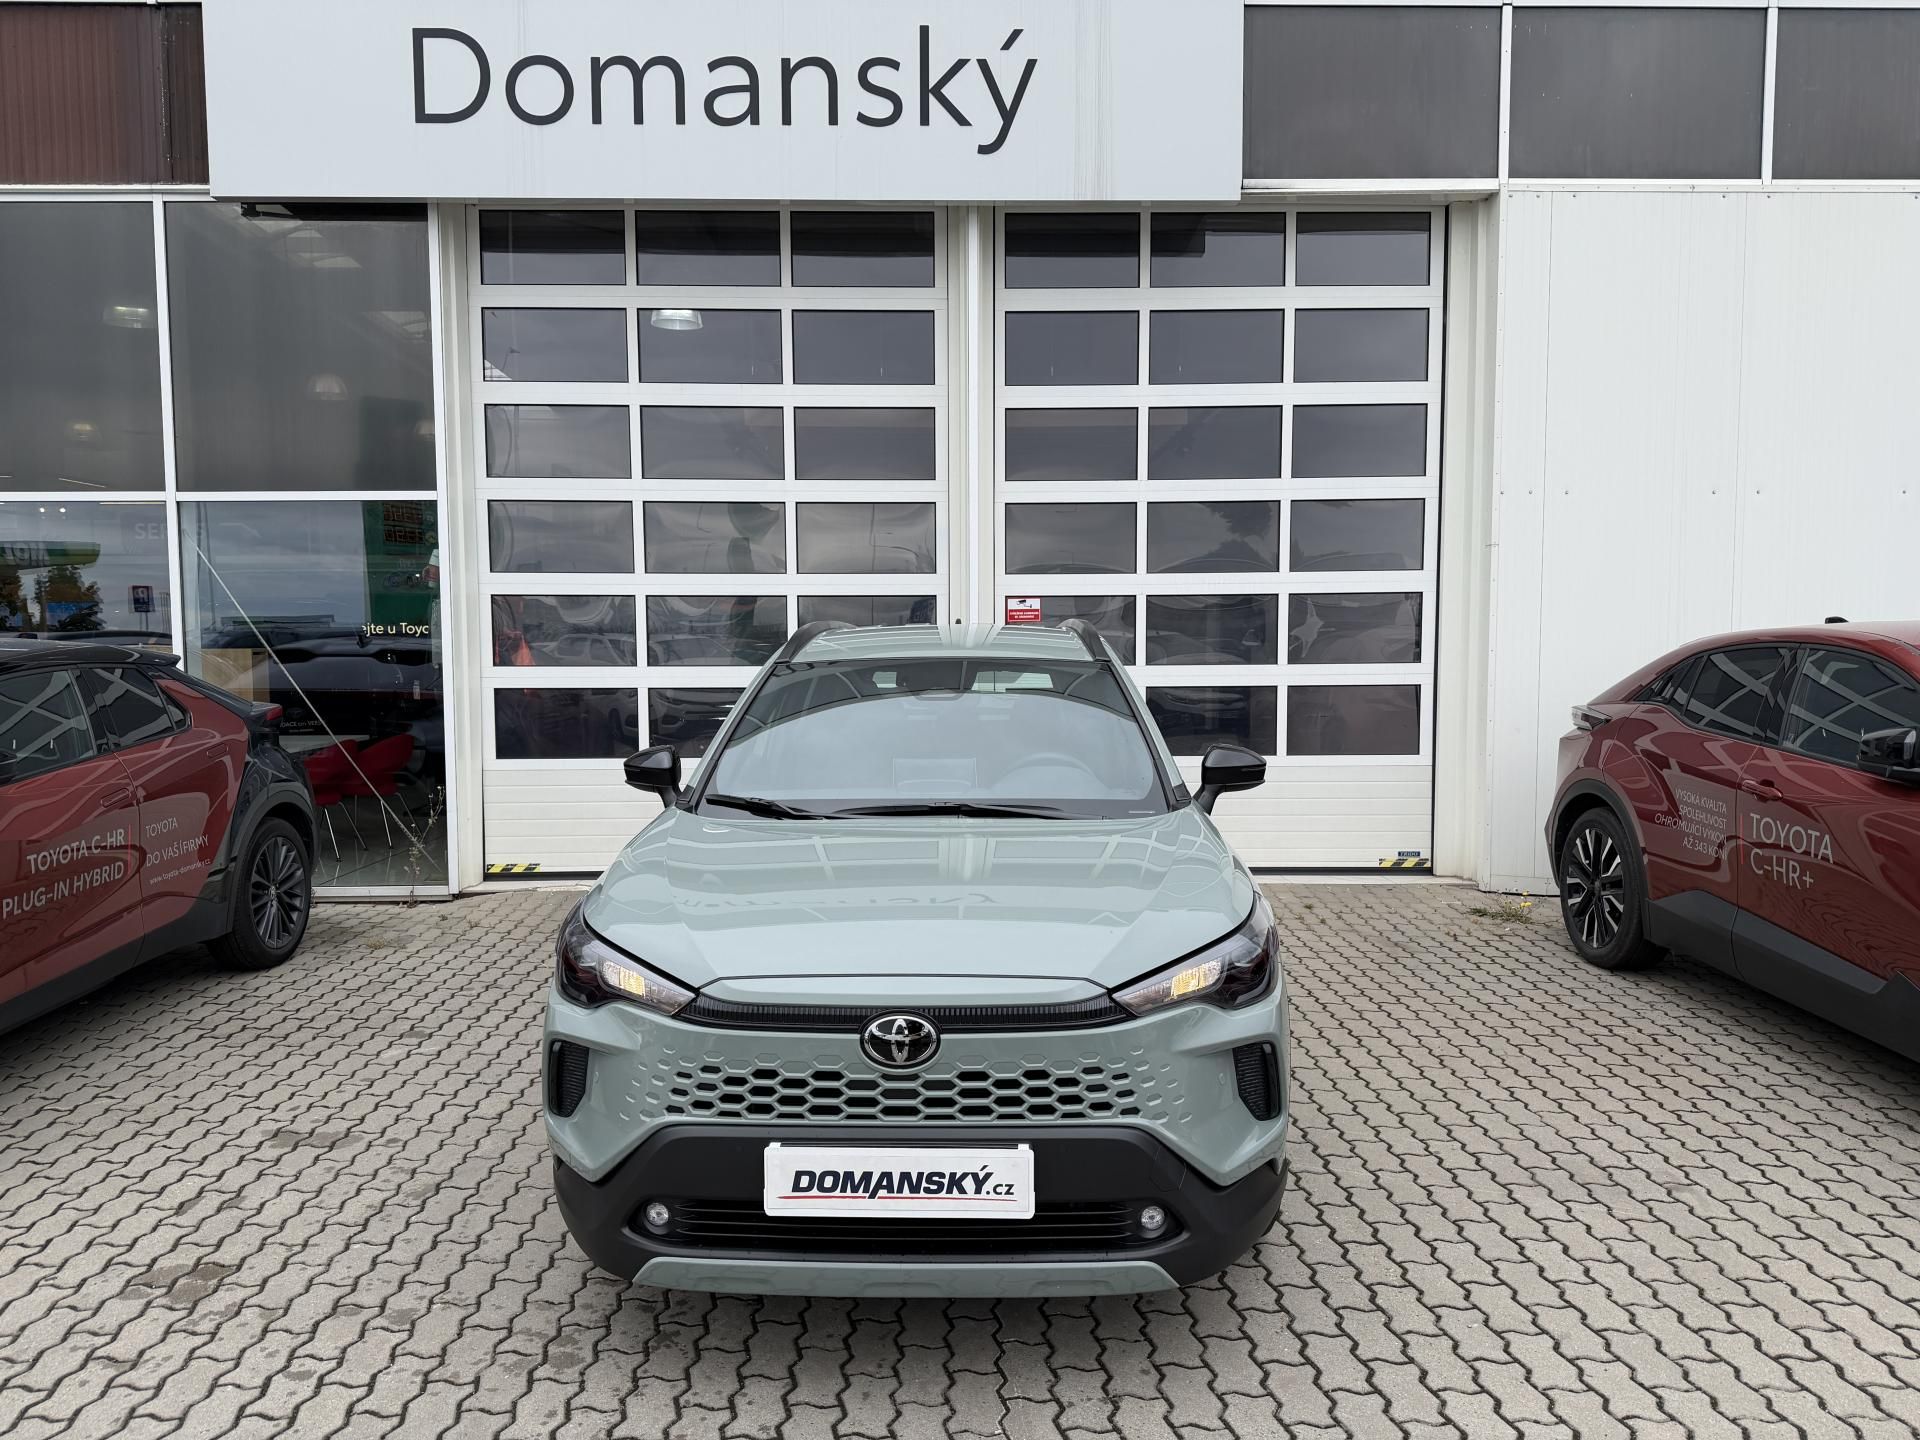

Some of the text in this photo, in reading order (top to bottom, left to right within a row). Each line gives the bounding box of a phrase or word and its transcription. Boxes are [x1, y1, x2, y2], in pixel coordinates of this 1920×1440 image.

[412, 24, 1038, 155] Domanský
[387, 625, 396, 634] u
[1679, 804, 1727, 830] SPOLEHLIVOST
[1701, 797, 1727, 814] KVALITA
[145, 817, 178, 838] TOYOTA
[1682, 834, 1694, 850] AŽ
[1694, 840, 1708, 854] 343
[1749, 812, 1834, 865] TOYOTA
[26, 828, 126, 875] TOYOTA C-HR
[146, 851, 161, 868] DO
[182, 834, 209, 855] FIRMY
[1750, 847, 1815, 891] C-HR+
[2, 861, 125, 920] PLUG-IN HYBRID
